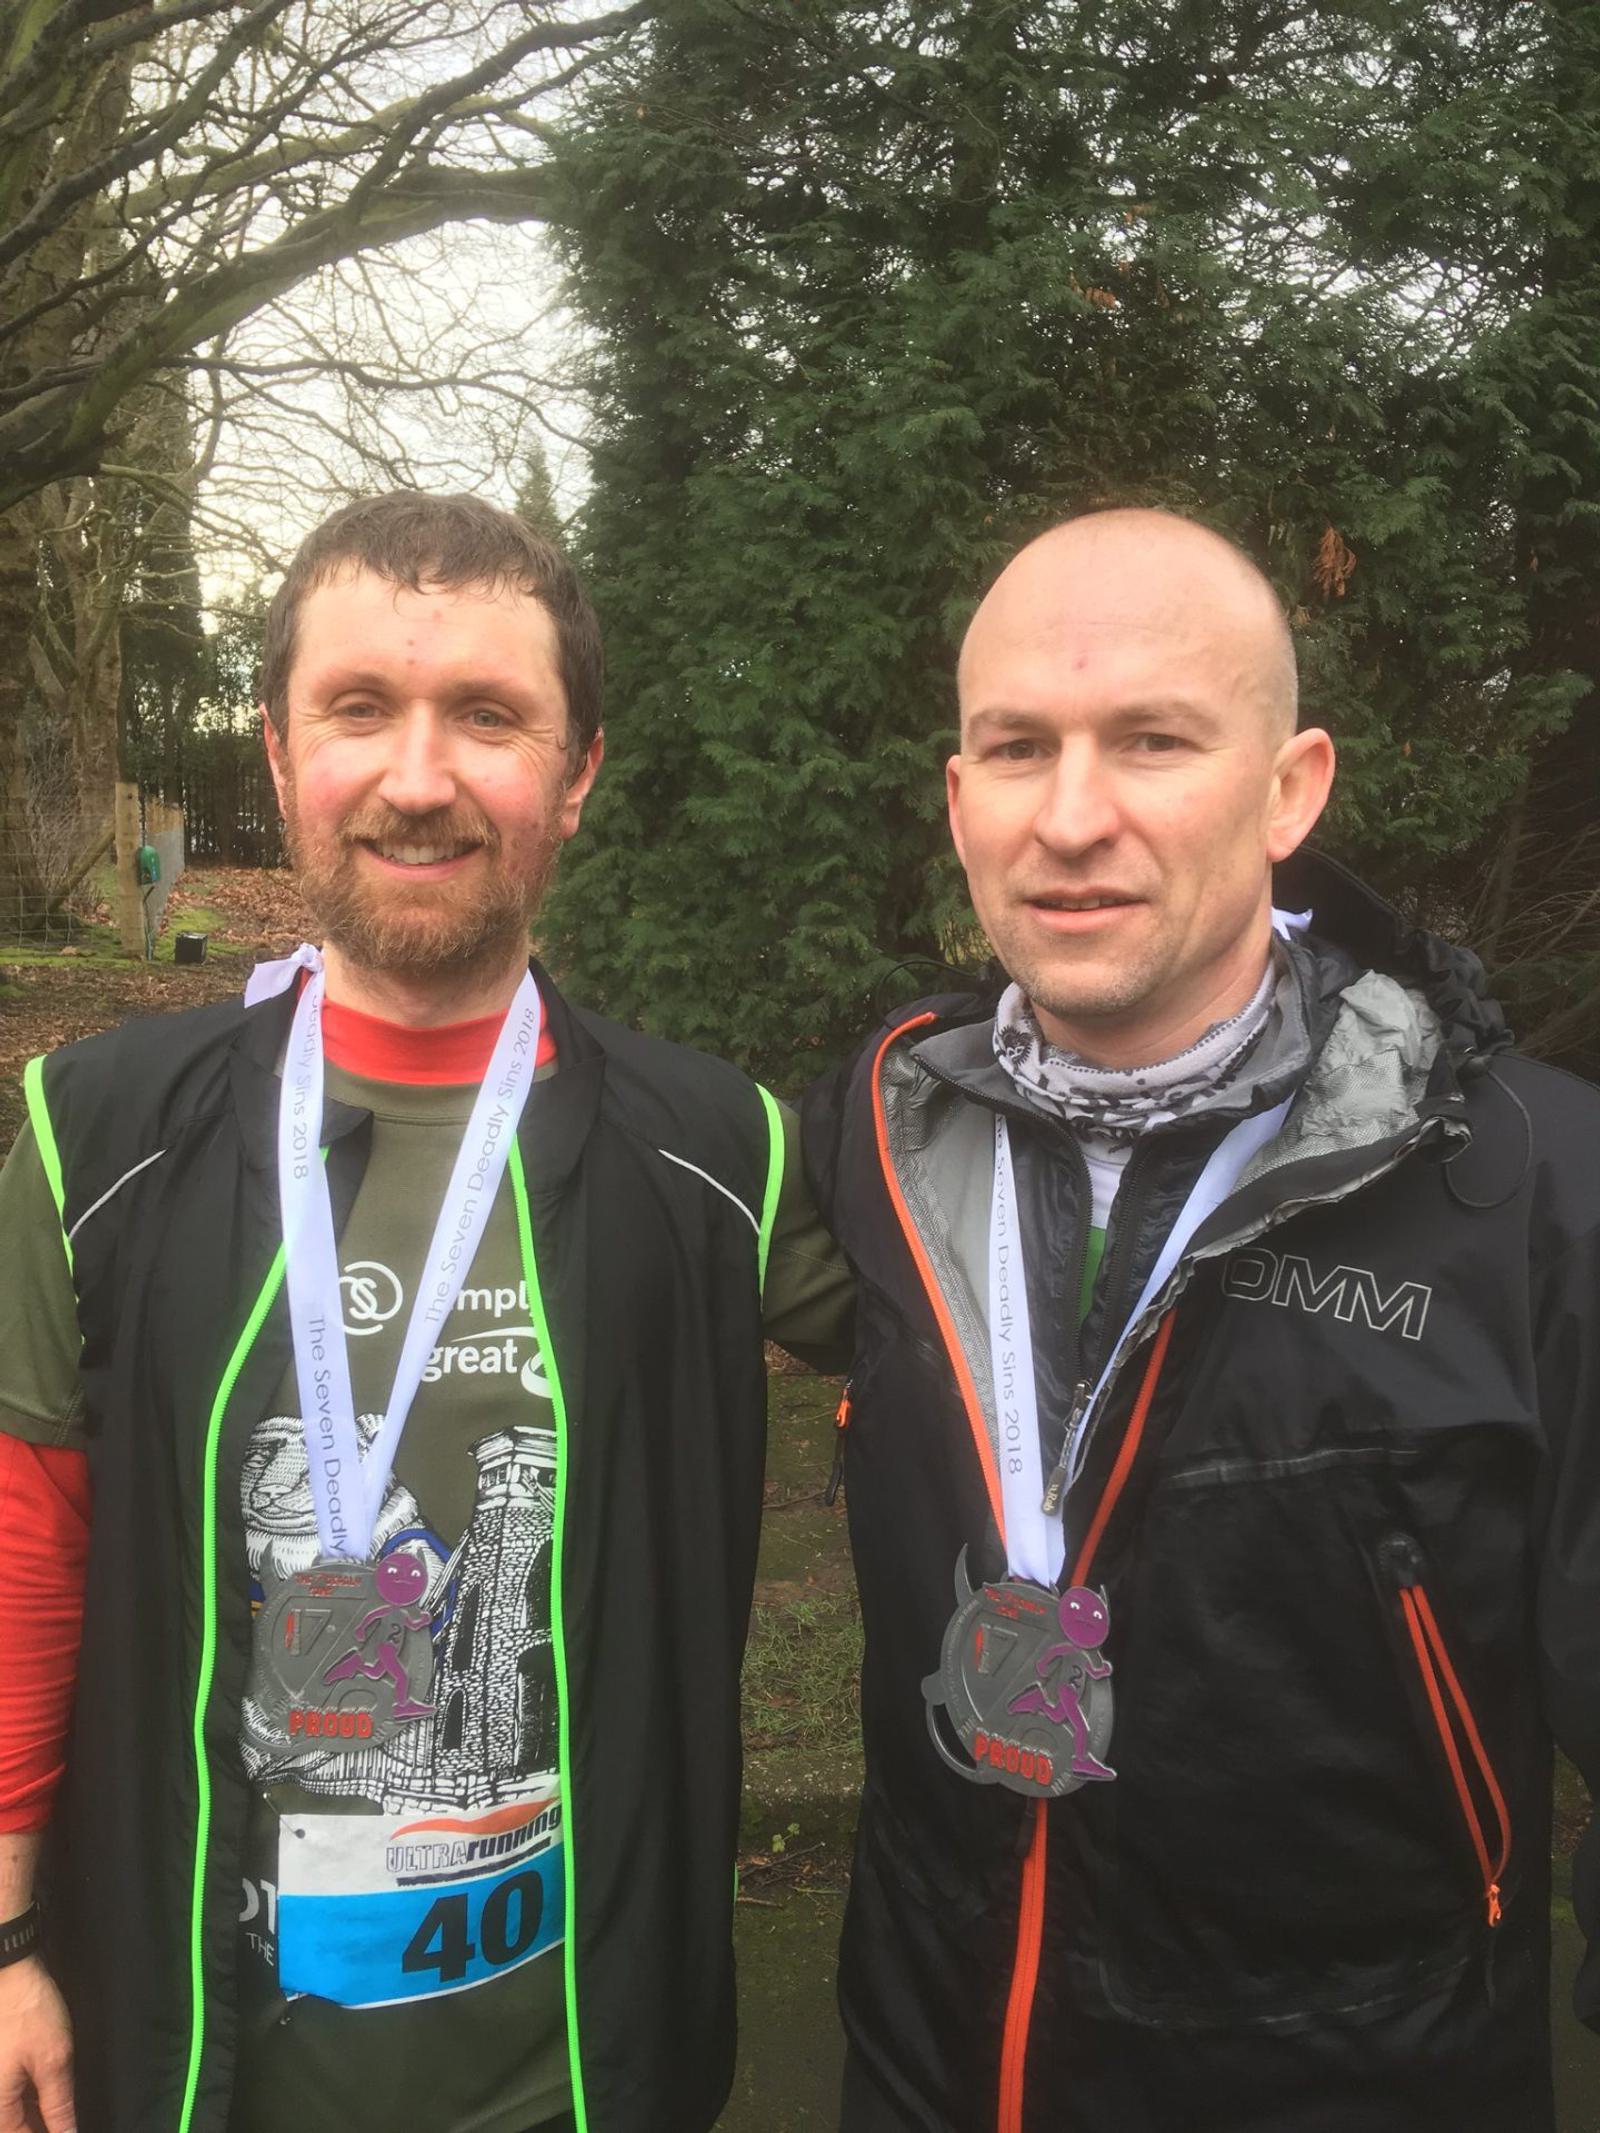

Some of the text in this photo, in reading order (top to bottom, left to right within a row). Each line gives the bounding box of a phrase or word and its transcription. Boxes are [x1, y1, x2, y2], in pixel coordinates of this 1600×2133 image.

[293, 1073, 312, 1116] Sins
[293, 1122, 308, 1180] 2018
[425, 1009, 534, 1322] The Seven Deadly Sins 2018
[998, 1245, 1014, 1342] Deadly
[1221, 1247, 1432, 1340] OMM
[420, 1339, 518, 1382] great
[1002, 1350, 1016, 1400] Sins
[308, 1315, 345, 1554] The Seven Deadly
[1005, 1409, 1023, 1475] 2018
[287, 1708, 374, 1738] PROUD
[973, 1727, 1054, 1786] PROUD
[385, 1803, 562, 1873] ULTRArunning
[245, 1932, 275, 1967] THE
[401, 1869, 544, 1983] 40
